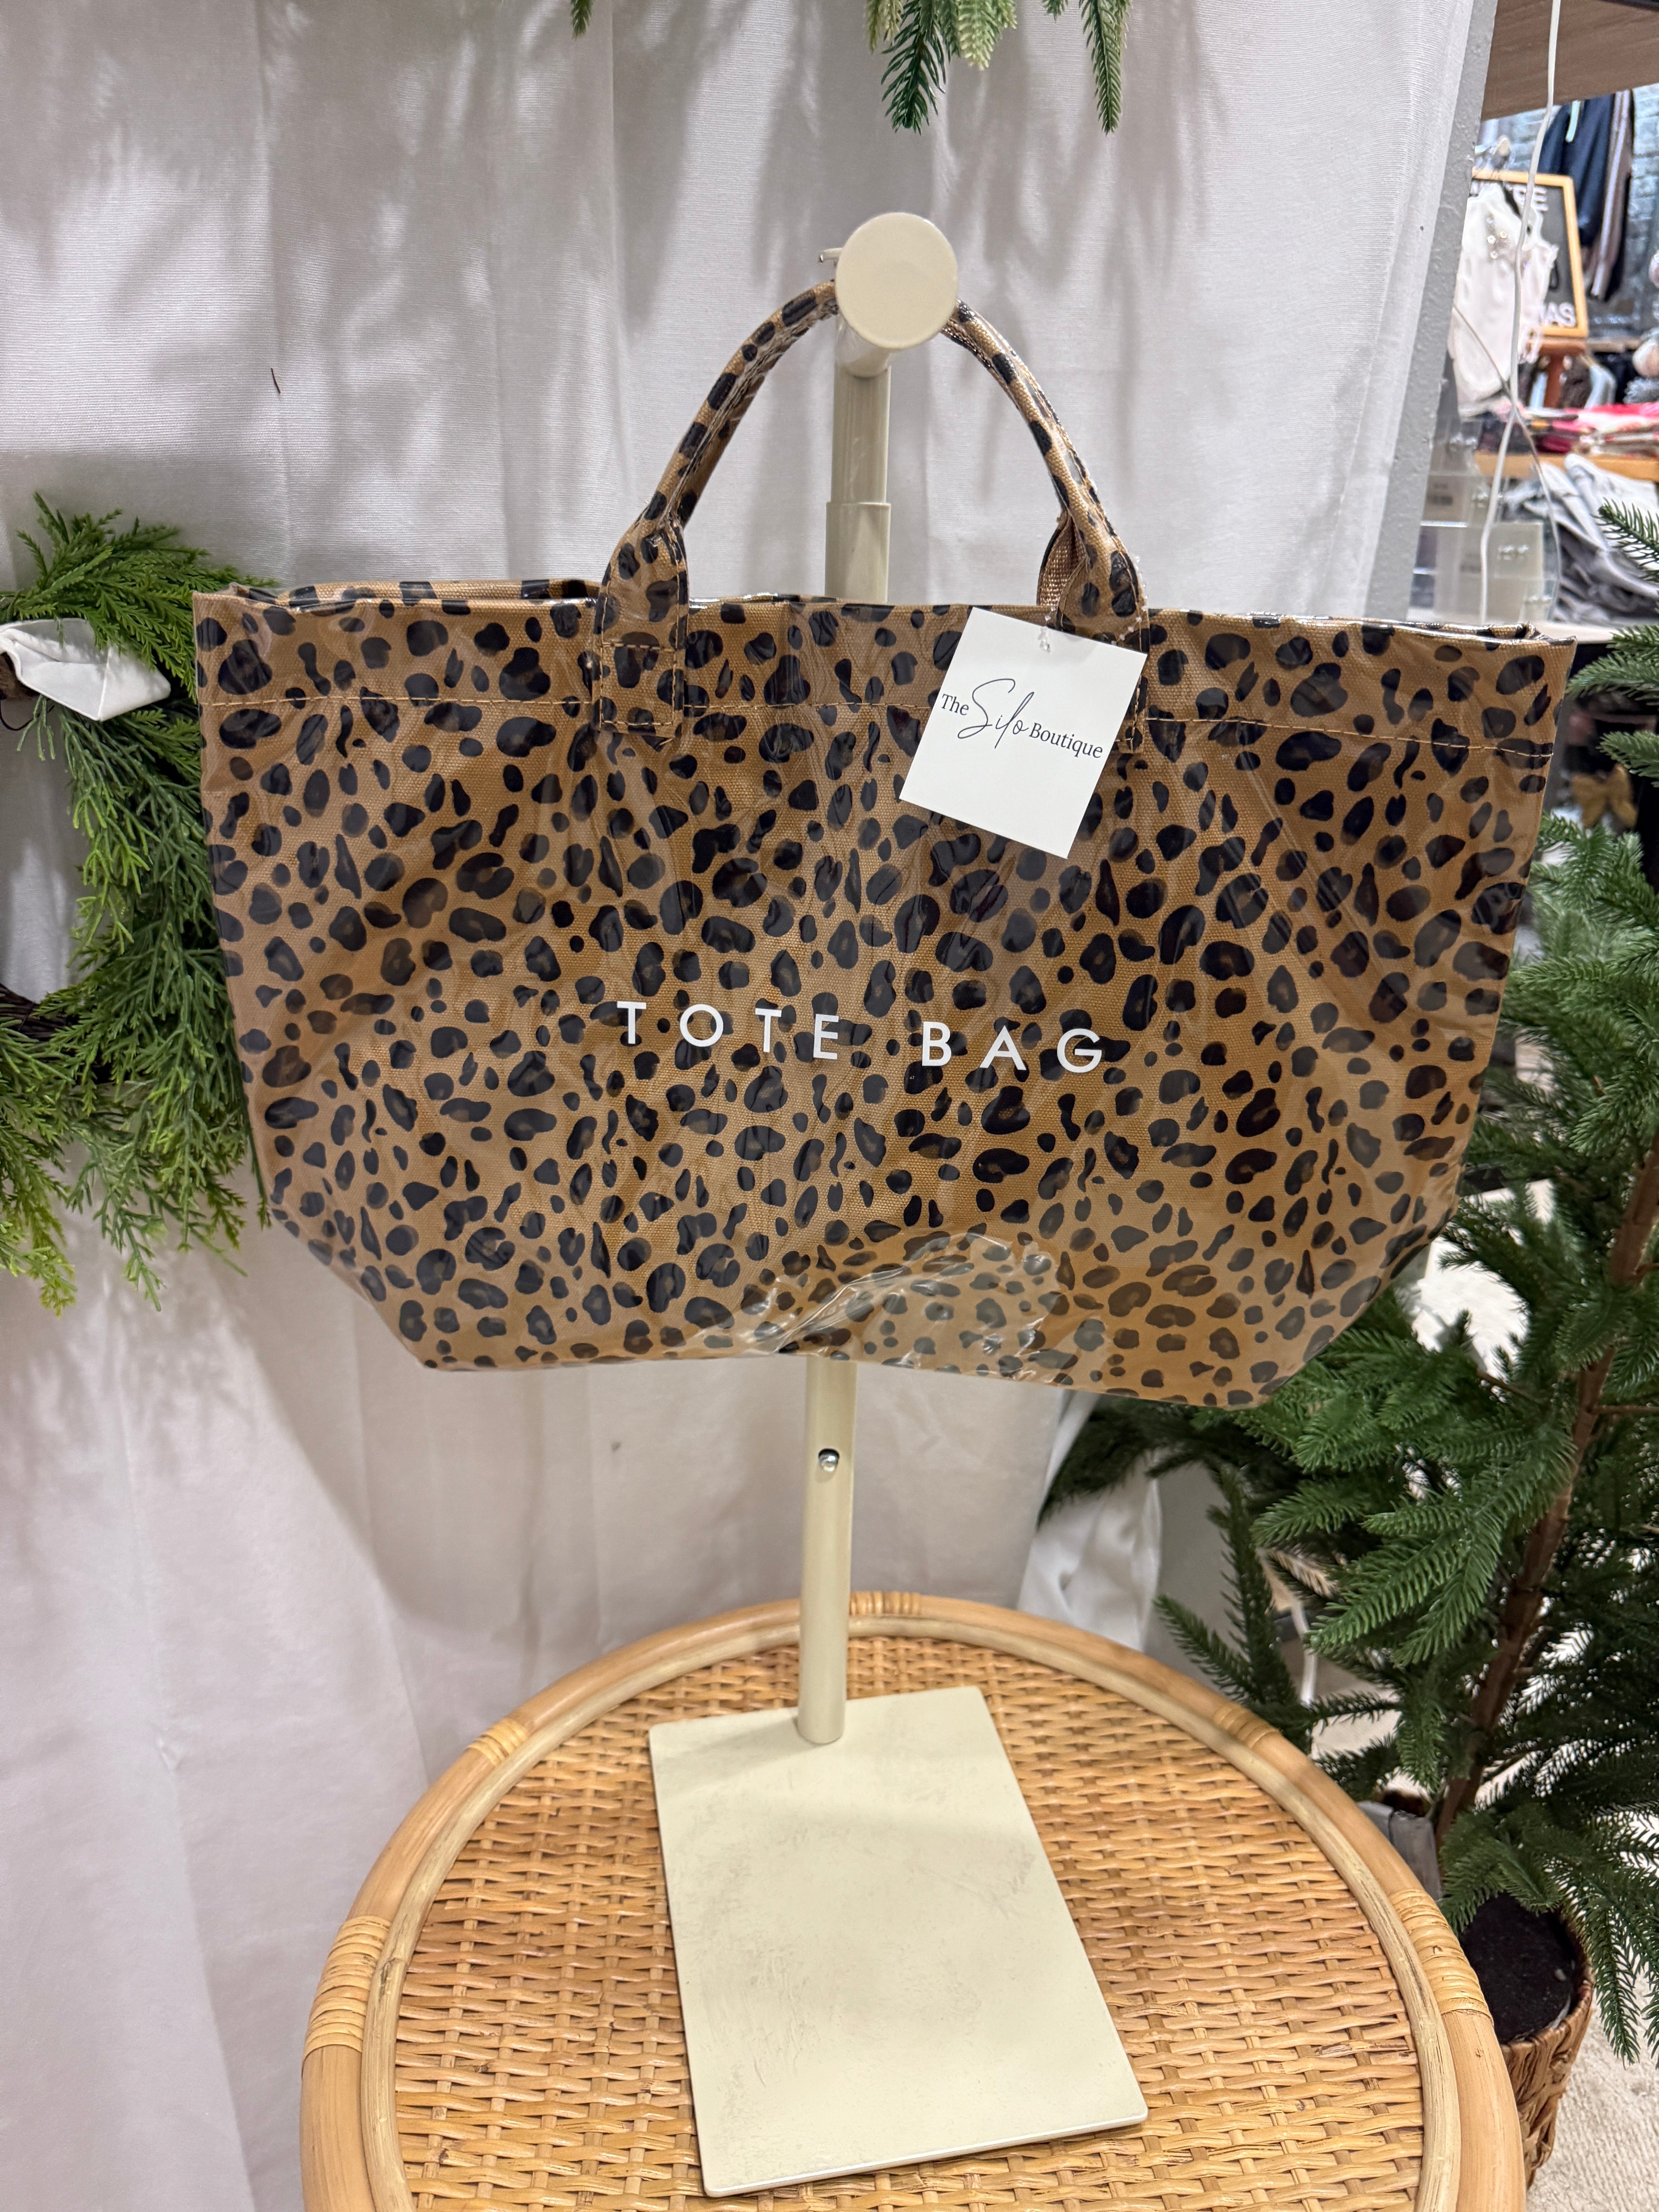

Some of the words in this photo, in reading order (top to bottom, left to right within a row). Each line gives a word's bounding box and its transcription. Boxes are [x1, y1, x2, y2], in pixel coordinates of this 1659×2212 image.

[941, 694, 969, 716] The
[957, 678, 1035, 749] Silo
[1029, 722, 1103, 758] Boutique
[617, 1001, 840, 1060] TOTE
[921, 1021, 1102, 1073] BAG
